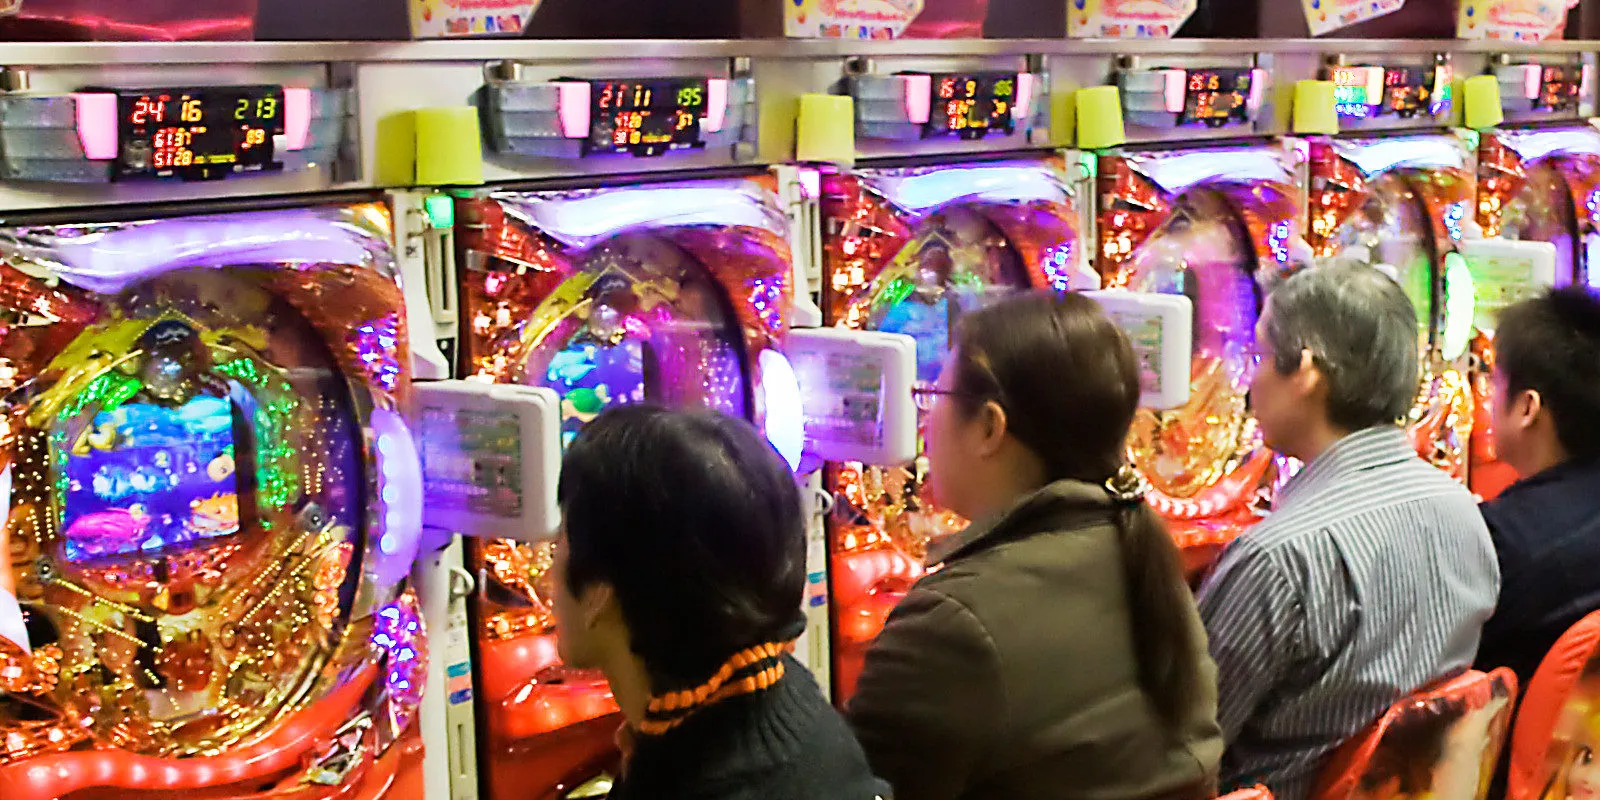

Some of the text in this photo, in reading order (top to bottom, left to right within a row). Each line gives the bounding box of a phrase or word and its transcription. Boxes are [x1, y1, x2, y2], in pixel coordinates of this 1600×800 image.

[599, 89, 623, 108] 21
[633, 89, 652, 107] 11
[677, 87, 703, 106] 195
[132, 101, 164, 124] 24
[181, 99, 203, 122] 16
[235, 98, 276, 120] 213
